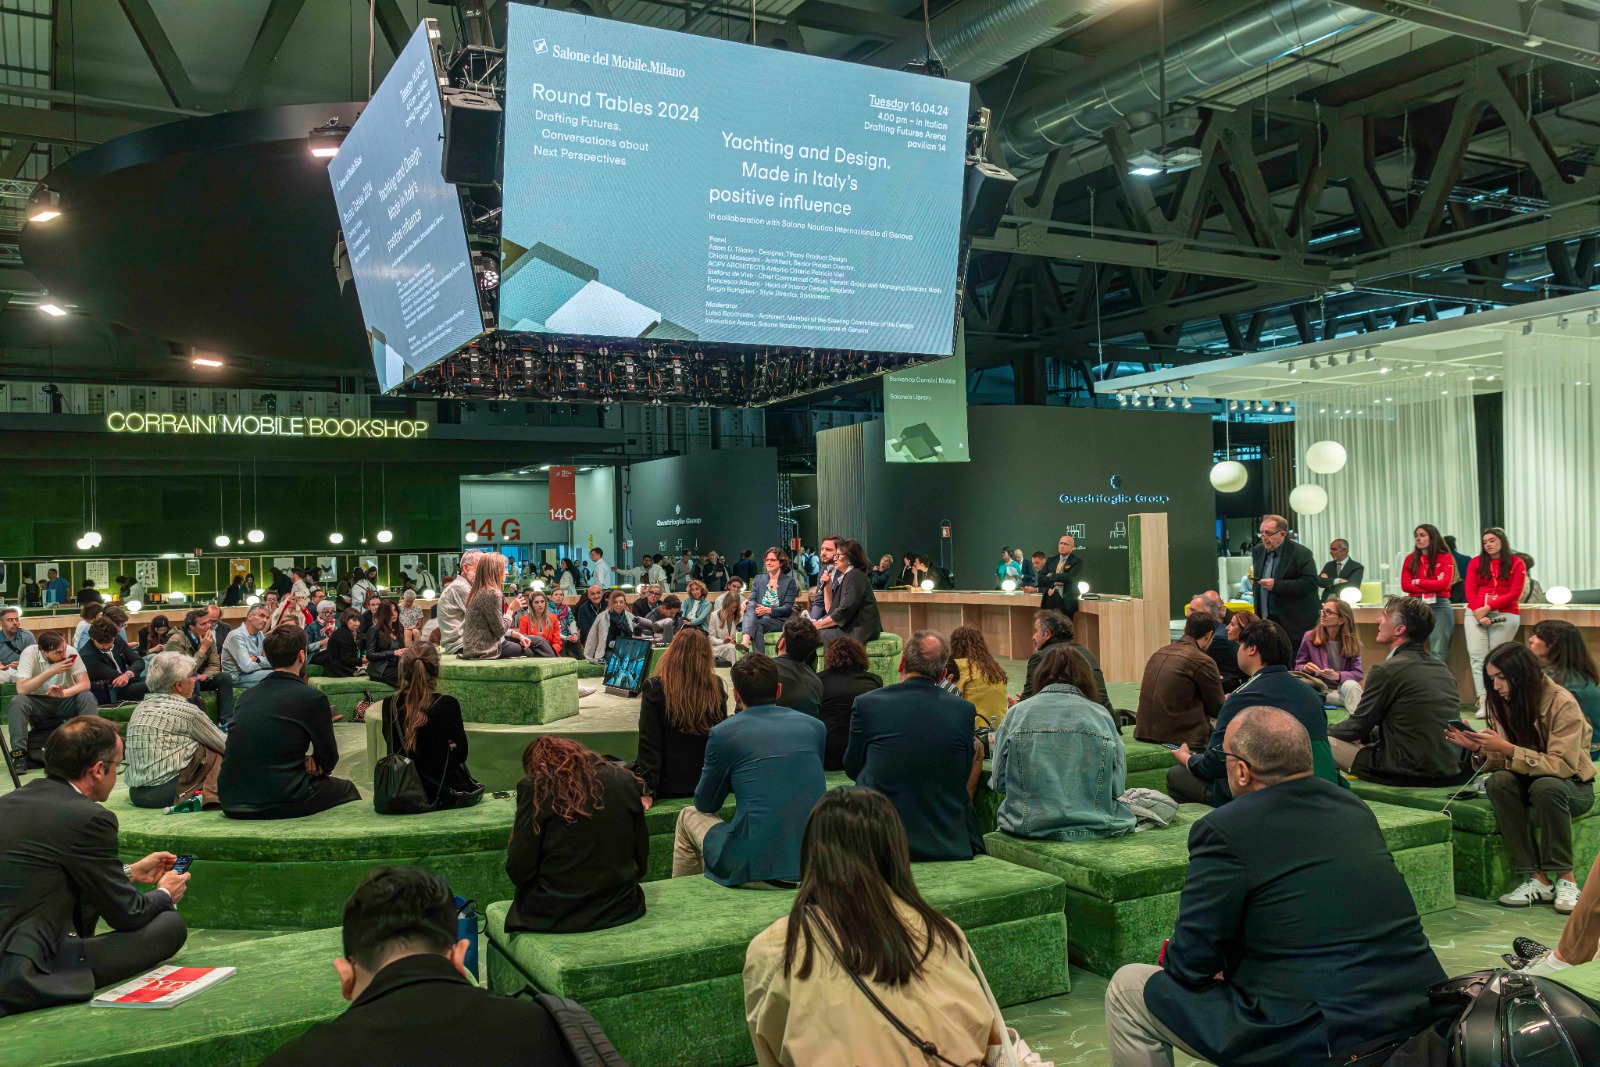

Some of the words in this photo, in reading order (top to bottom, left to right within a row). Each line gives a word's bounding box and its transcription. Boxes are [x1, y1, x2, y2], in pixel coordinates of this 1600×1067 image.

[552, 44, 589, 62] Salone
[592, 50, 608, 66] del
[532, 82, 590, 107] Round
[595, 91, 652, 116] Tables
[657, 100, 699, 122] 2024
[869, 93, 908, 112] Tuesday
[910, 100, 948, 116] 16.04.24
[534, 109, 578, 126] Drafting
[580, 116, 621, 131] Futures.
[863, 121, 894, 134] Drafting
[896, 126, 923, 137] Futures
[924, 130, 946, 141] Arena
[877, 111, 894, 121] 4.00
[895, 115, 907, 125] pm
[915, 117, 922, 126] in
[924, 118, 947, 129] Italian
[541, 128, 616, 147] Conversations
[619, 138, 648, 151] about
[721, 130, 794, 160] Yachting
[798, 141, 829, 161] and
[834, 146, 891, 172] Design.
[907, 139, 936, 151] pavilion
[937, 143, 945, 151] 14
[533, 144, 557, 157] Next
[561, 147, 626, 167] Perspectives
[742, 161, 789, 182] Made
[794, 167, 807, 184] in
[709, 184, 774, 209] positive
[779, 192, 851, 215] influence
[708, 212, 715, 220] In
[716, 212, 764, 225] collaboration
[765, 217, 780, 226] with
[781, 219, 805, 229] Salone
[807, 222, 833, 231] Nautico
[834, 224, 880, 236] Internazionale
[106, 412, 216, 434] CORRAINI
[222, 414, 304, 436] MOBILE
[310, 416, 428, 438] BOOKSHOP
[1059, 494, 1132, 504] Quadrifoglio
[1134, 494, 1170, 504] Group
[550, 508, 574, 520] 14C
[466, 519, 495, 541] 14
[501, 518, 520, 541] G
